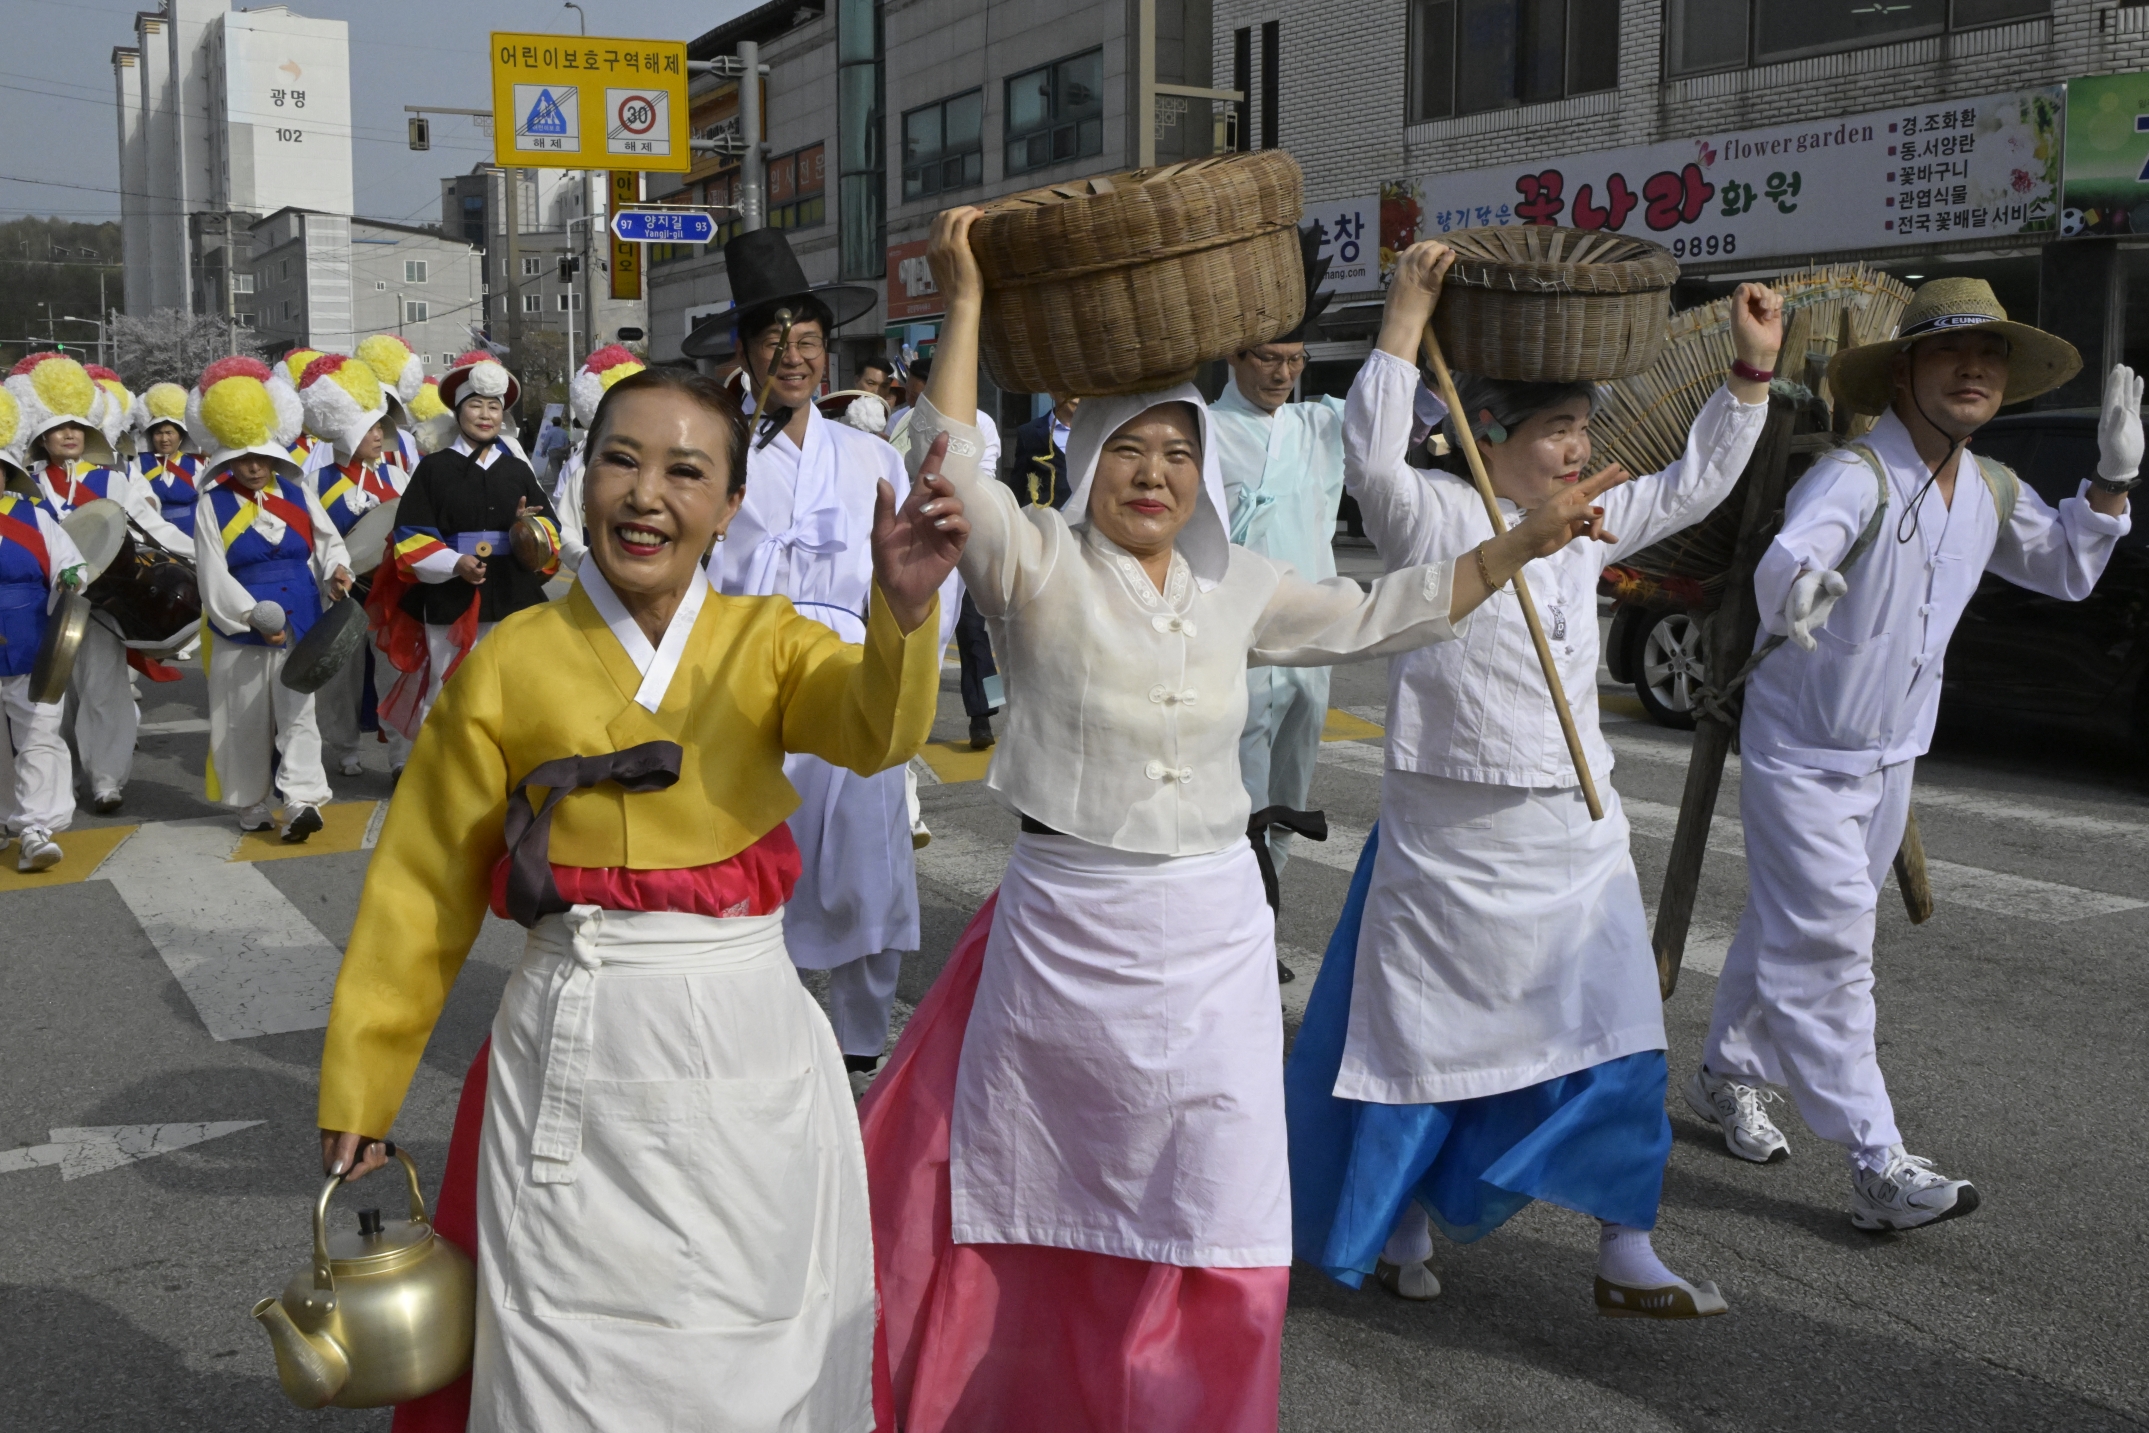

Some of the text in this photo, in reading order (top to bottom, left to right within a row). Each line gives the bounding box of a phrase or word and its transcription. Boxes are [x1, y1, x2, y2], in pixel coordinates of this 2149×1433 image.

[501, 45, 680, 75] 어린이보호구역해제
[270, 89, 306, 108] 광명
[627, 106, 648, 124] 30
[1902, 108, 1976, 136] 경.조화환
[275, 128, 303, 142] 102
[1724, 124, 1874, 160] flower garden
[1900, 133, 1976, 161] 동.서양란
[1899, 159, 1968, 186] 꽃바구니
[1514, 162, 1716, 231] 꽃나라
[1721, 171, 1801, 217] 화원
[1898, 184, 1968, 210] 관엽식물
[620, 220, 632, 230] 97
[644, 215, 682, 230] 양지길
[695, 222, 708, 232] 93
[1898, 203, 2048, 234] 전국 꽃배달 서비스
[644, 229, 684, 239] Yangji-gil
[1673, 233, 1736, 258] 9898
[1877, 1182, 1899, 1203] N
